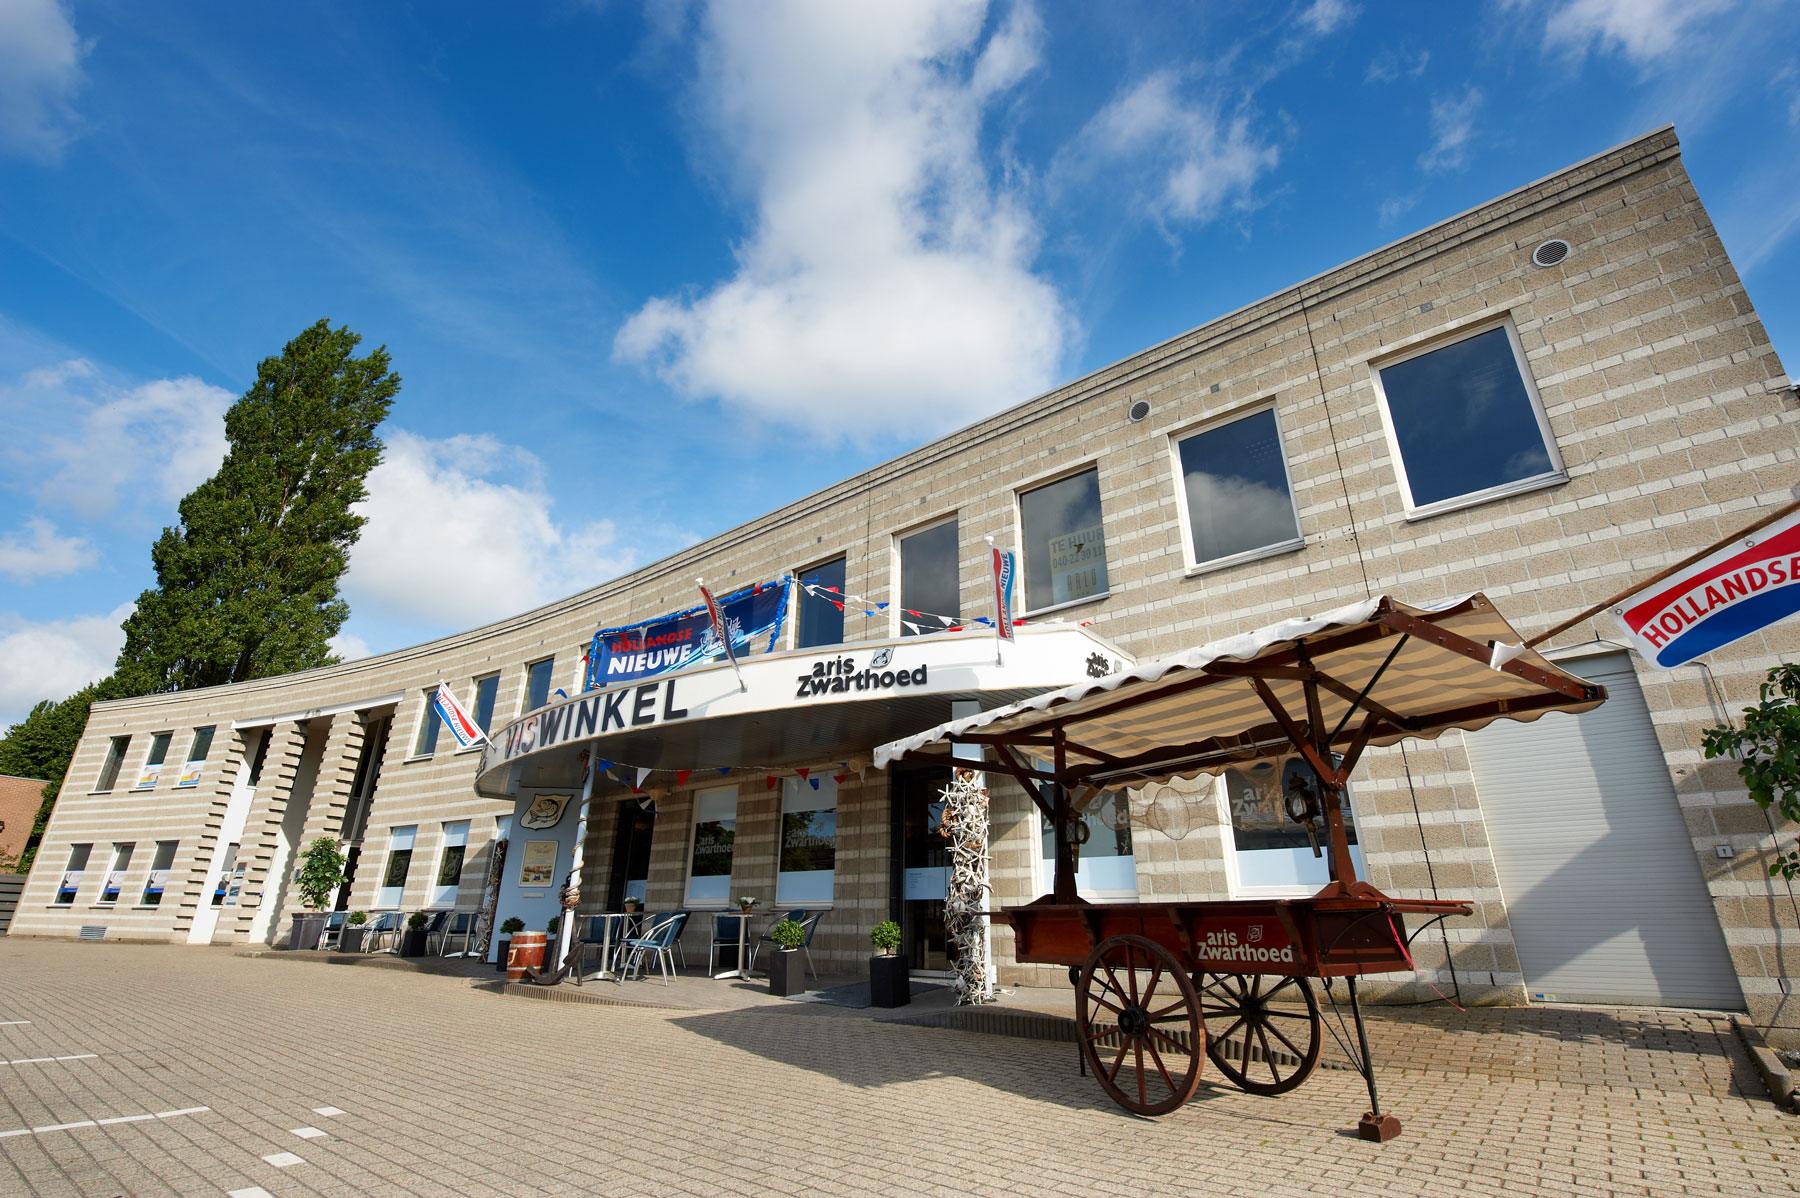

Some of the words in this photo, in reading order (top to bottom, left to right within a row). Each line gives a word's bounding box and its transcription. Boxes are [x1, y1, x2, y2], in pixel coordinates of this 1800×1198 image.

[1051, 540, 1066, 553] TE
[1000, 553, 1010, 589] NIEUWE
[1642, 556, 1800, 649] HOLLANDSE
[611, 627, 693, 655] HOLLANDSE
[607, 644, 693, 675] NIEUWE
[812, 655, 855, 678] aris
[796, 664, 928, 697] Zwarthoed
[505, 680, 688, 760] VISWINKEL
[1206, 928, 1238, 946] aris
[1196, 942, 1294, 963] Zwarthoed
